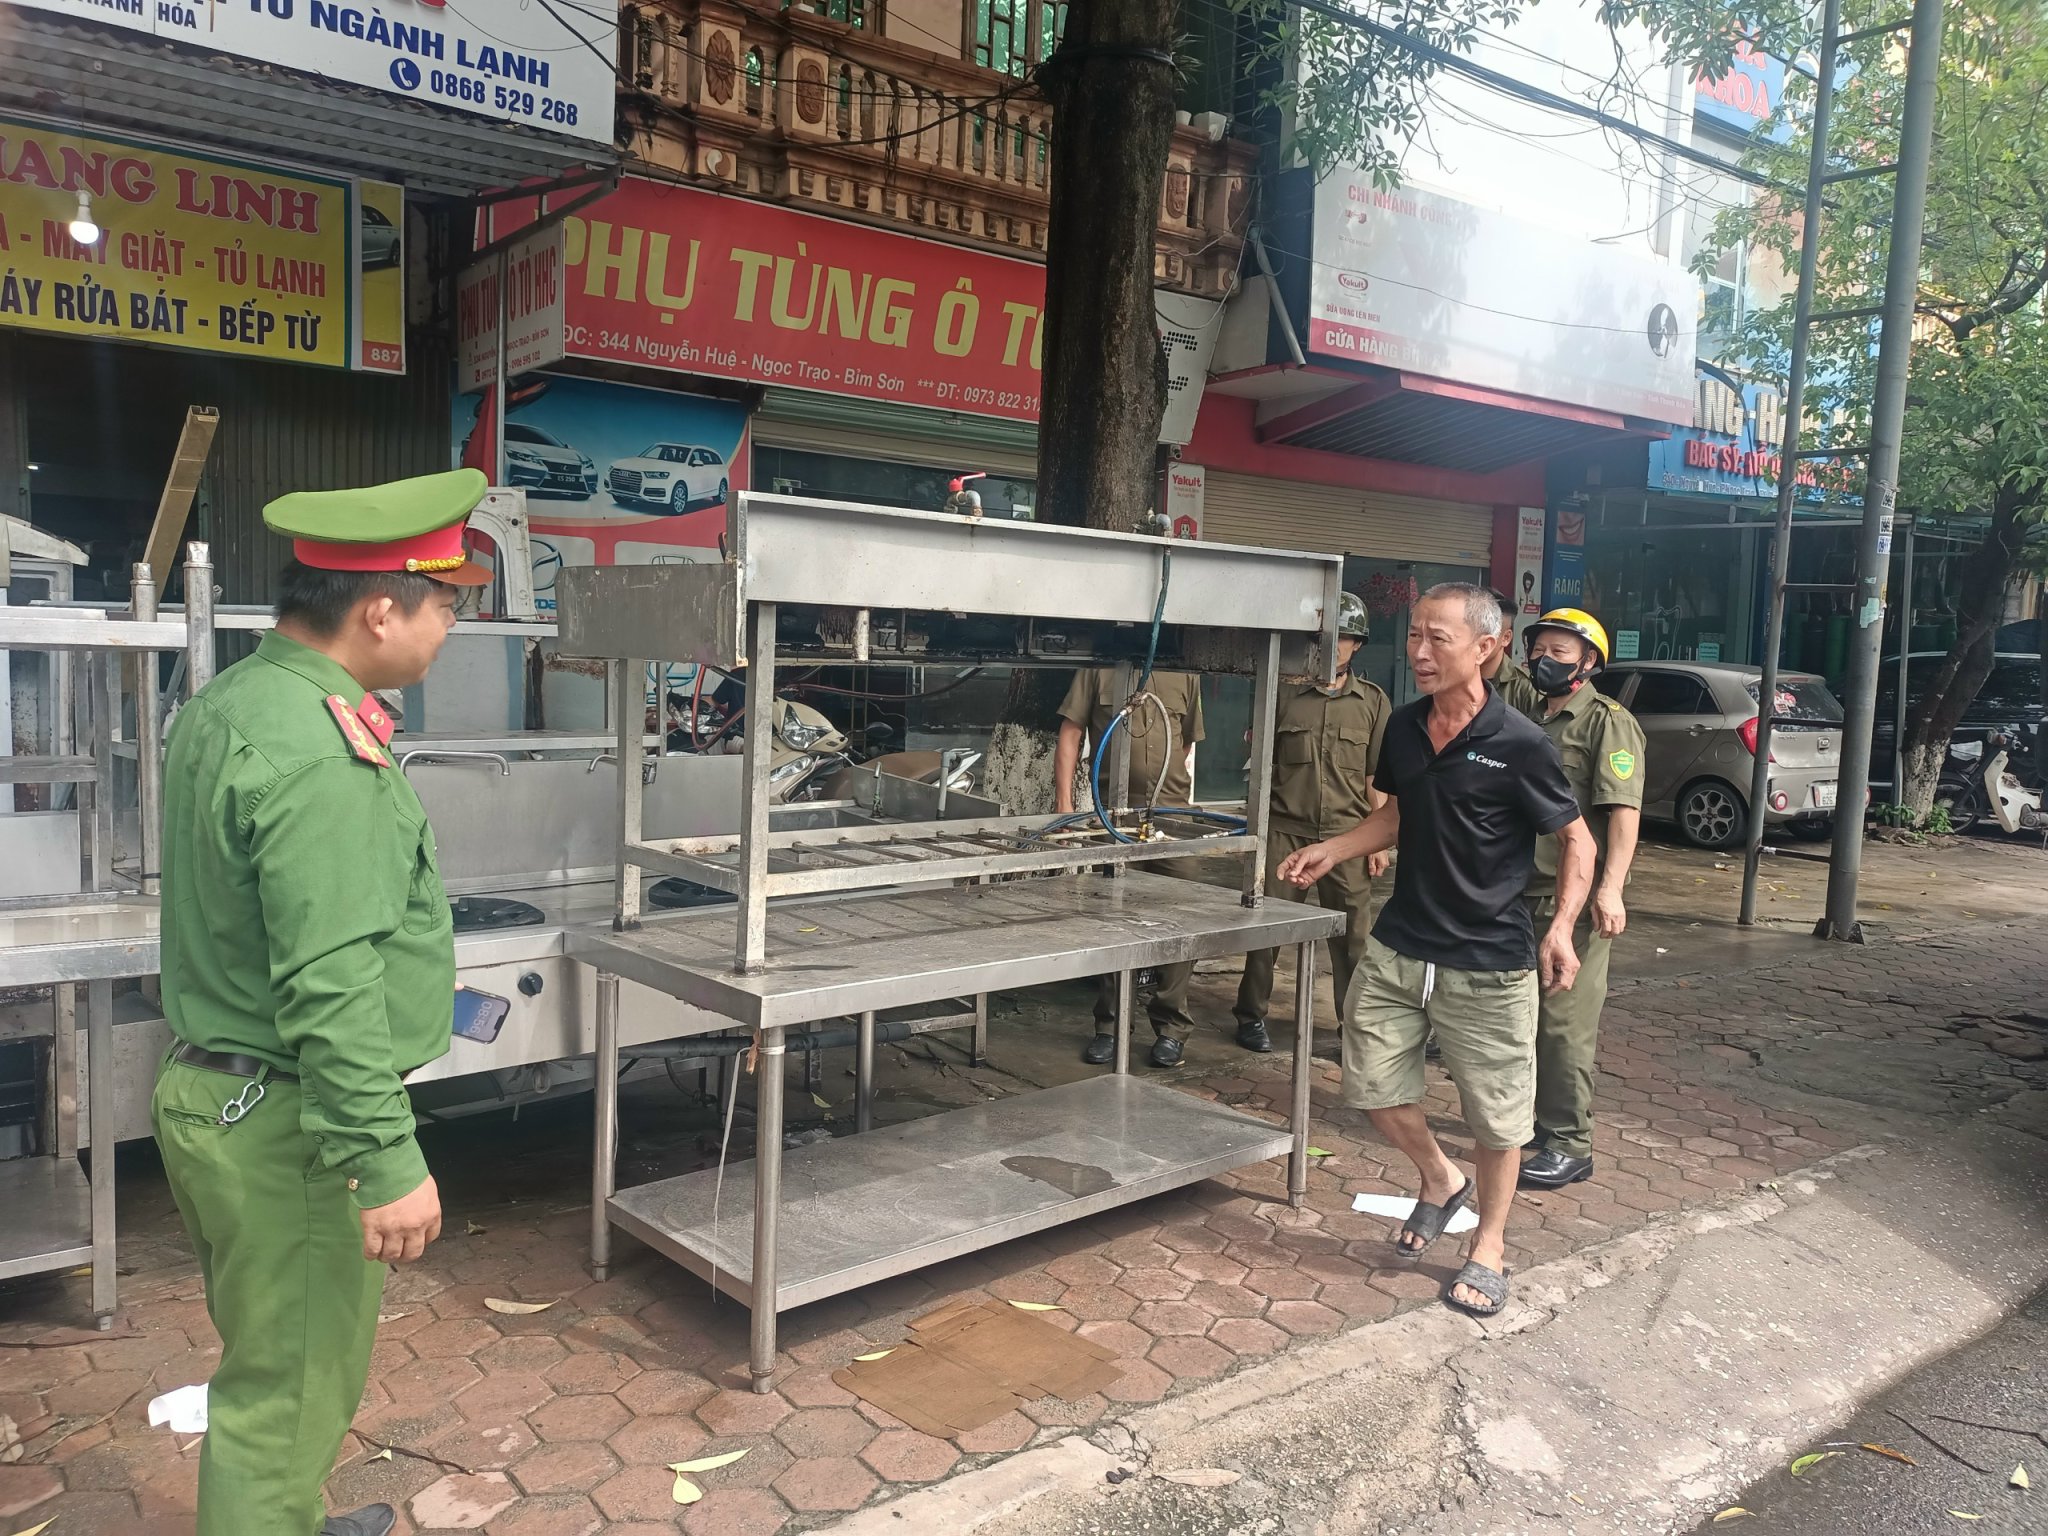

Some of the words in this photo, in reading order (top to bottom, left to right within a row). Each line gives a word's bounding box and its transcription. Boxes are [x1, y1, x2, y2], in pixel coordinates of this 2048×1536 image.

[157, 2, 197, 29] HÓA
[310, 0, 444, 60] NGÀNH
[457, 38, 549, 88] LẠNH
[431, 69, 485, 104] 0868
[495, 85, 534, 116] 529
[541, 97, 578, 126] 268
[174, 168, 319, 234] LINH
[1347, 184, 1369, 204] CHI
[121, 229, 185, 282] GIẶT
[214, 238, 247, 286] TỦ
[256, 253, 326, 299] LẠNH
[1342, 276, 1364, 289] Yakult
[0, 268, 42, 316] ÁY
[54, 273, 120, 327] RỬA
[130, 289, 188, 334] BÁT
[219, 298, 275, 345] BẾP
[284, 309, 321, 351] TỪ
[461, 282, 480, 349] PHỤ
[481, 265, 498, 334] TÙN
[509, 251, 516, 322] Ô
[519, 245, 531, 318] TÔ
[534, 245, 556, 312] HHC
[729, 241, 916, 348] TÙNG
[933, 276, 980, 358] Ô
[370, 348, 400, 363] 887
[1325, 327, 1355, 350] CỬA
[1359, 336, 1399, 358] HÀNG
[599, 330, 629, 350] 344
[635, 336, 699, 362] Nguyễn
[705, 346, 737, 370] Huệ
[752, 354, 792, 377] Ngọc
[798, 361, 830, 383] Trạo
[844, 367, 872, 388] Bỉm
[877, 373, 905, 392] Sơn
[937, 382, 960, 400] ĐT:
[964, 386, 994, 405] 0973
[997, 392, 1019, 409] 822
[1172, 474, 1201, 487] Yakult
[1522, 516, 1542, 527] Yakult
[1476, 754, 1507, 768] Casper
